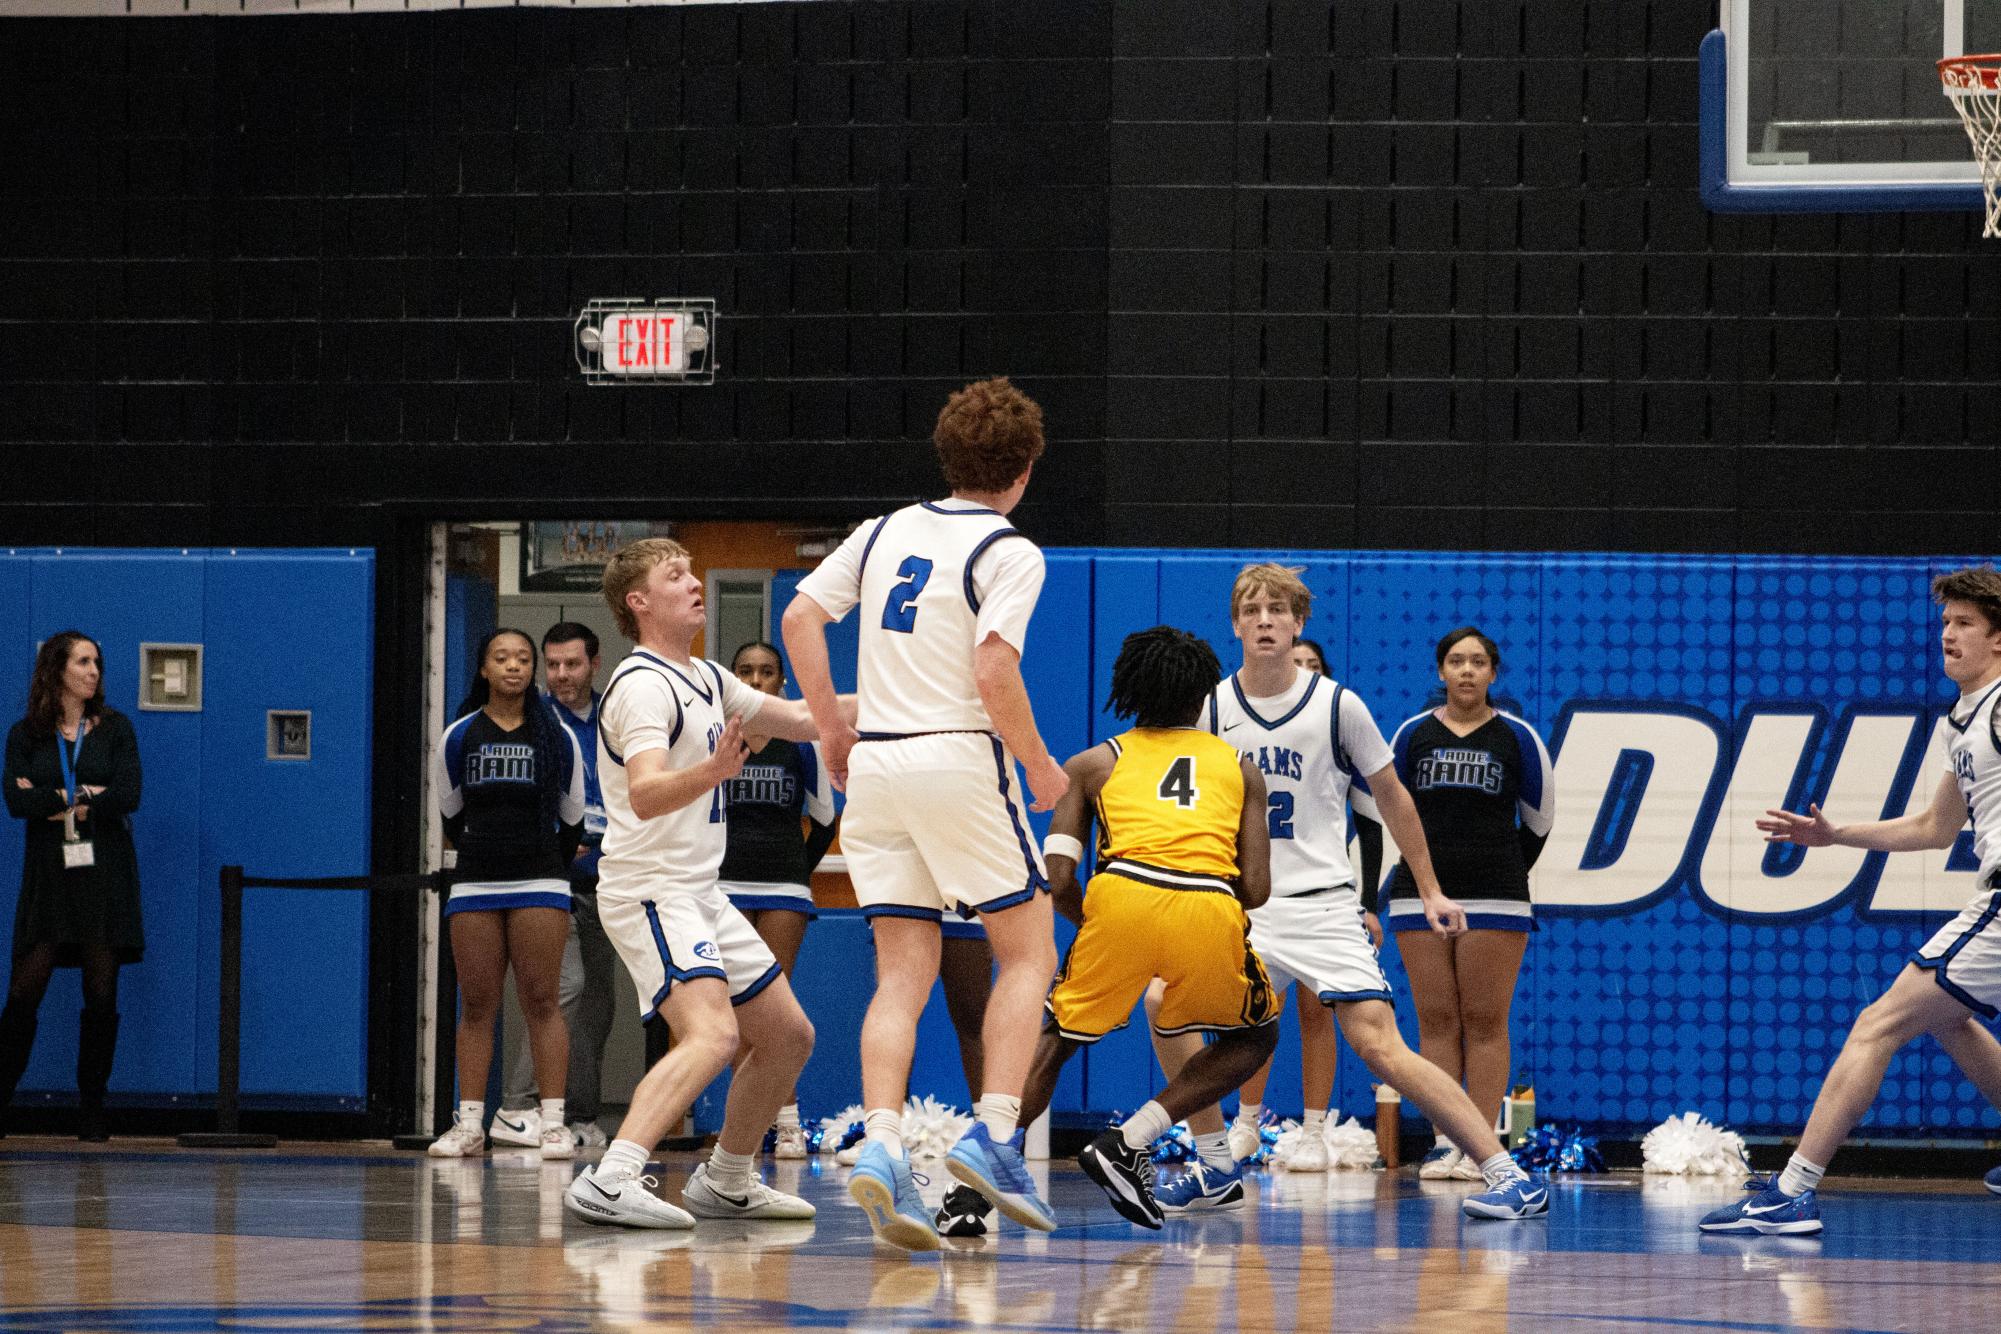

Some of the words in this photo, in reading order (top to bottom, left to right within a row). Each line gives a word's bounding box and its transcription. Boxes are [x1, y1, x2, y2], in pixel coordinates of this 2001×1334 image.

[618, 318, 674, 366] EXIT
[881, 555, 934, 634] 2
[466, 753, 535, 785] RAM
[741, 766, 783, 779] ADUE
[1245, 745, 1303, 782] AMS
[1433, 748, 1489, 764] LADUE
[1157, 756, 1200, 810] 4
[1416, 758, 1502, 794] RAMS
